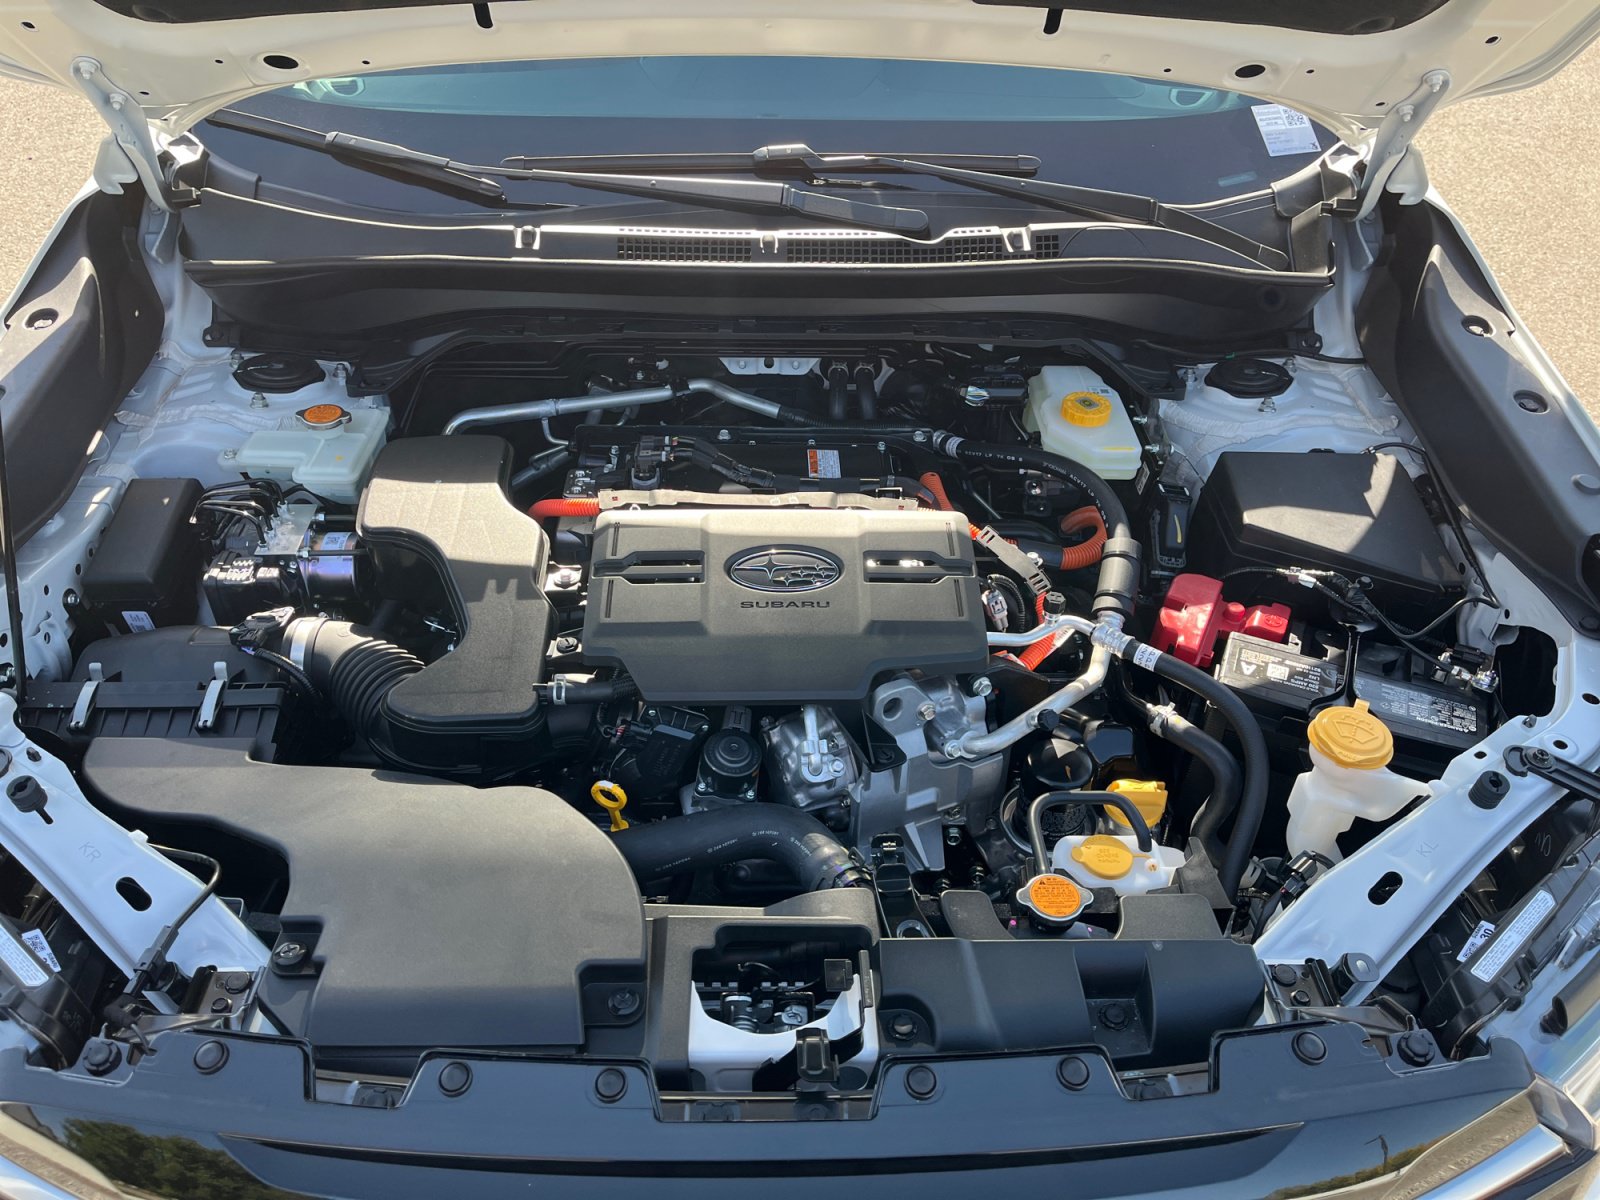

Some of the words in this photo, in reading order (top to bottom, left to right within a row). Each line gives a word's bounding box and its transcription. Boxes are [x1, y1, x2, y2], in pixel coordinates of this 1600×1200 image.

[740, 601, 830, 609] SUBARU
[78, 841, 102, 864] KR
[1415, 841, 1440, 858] KL
